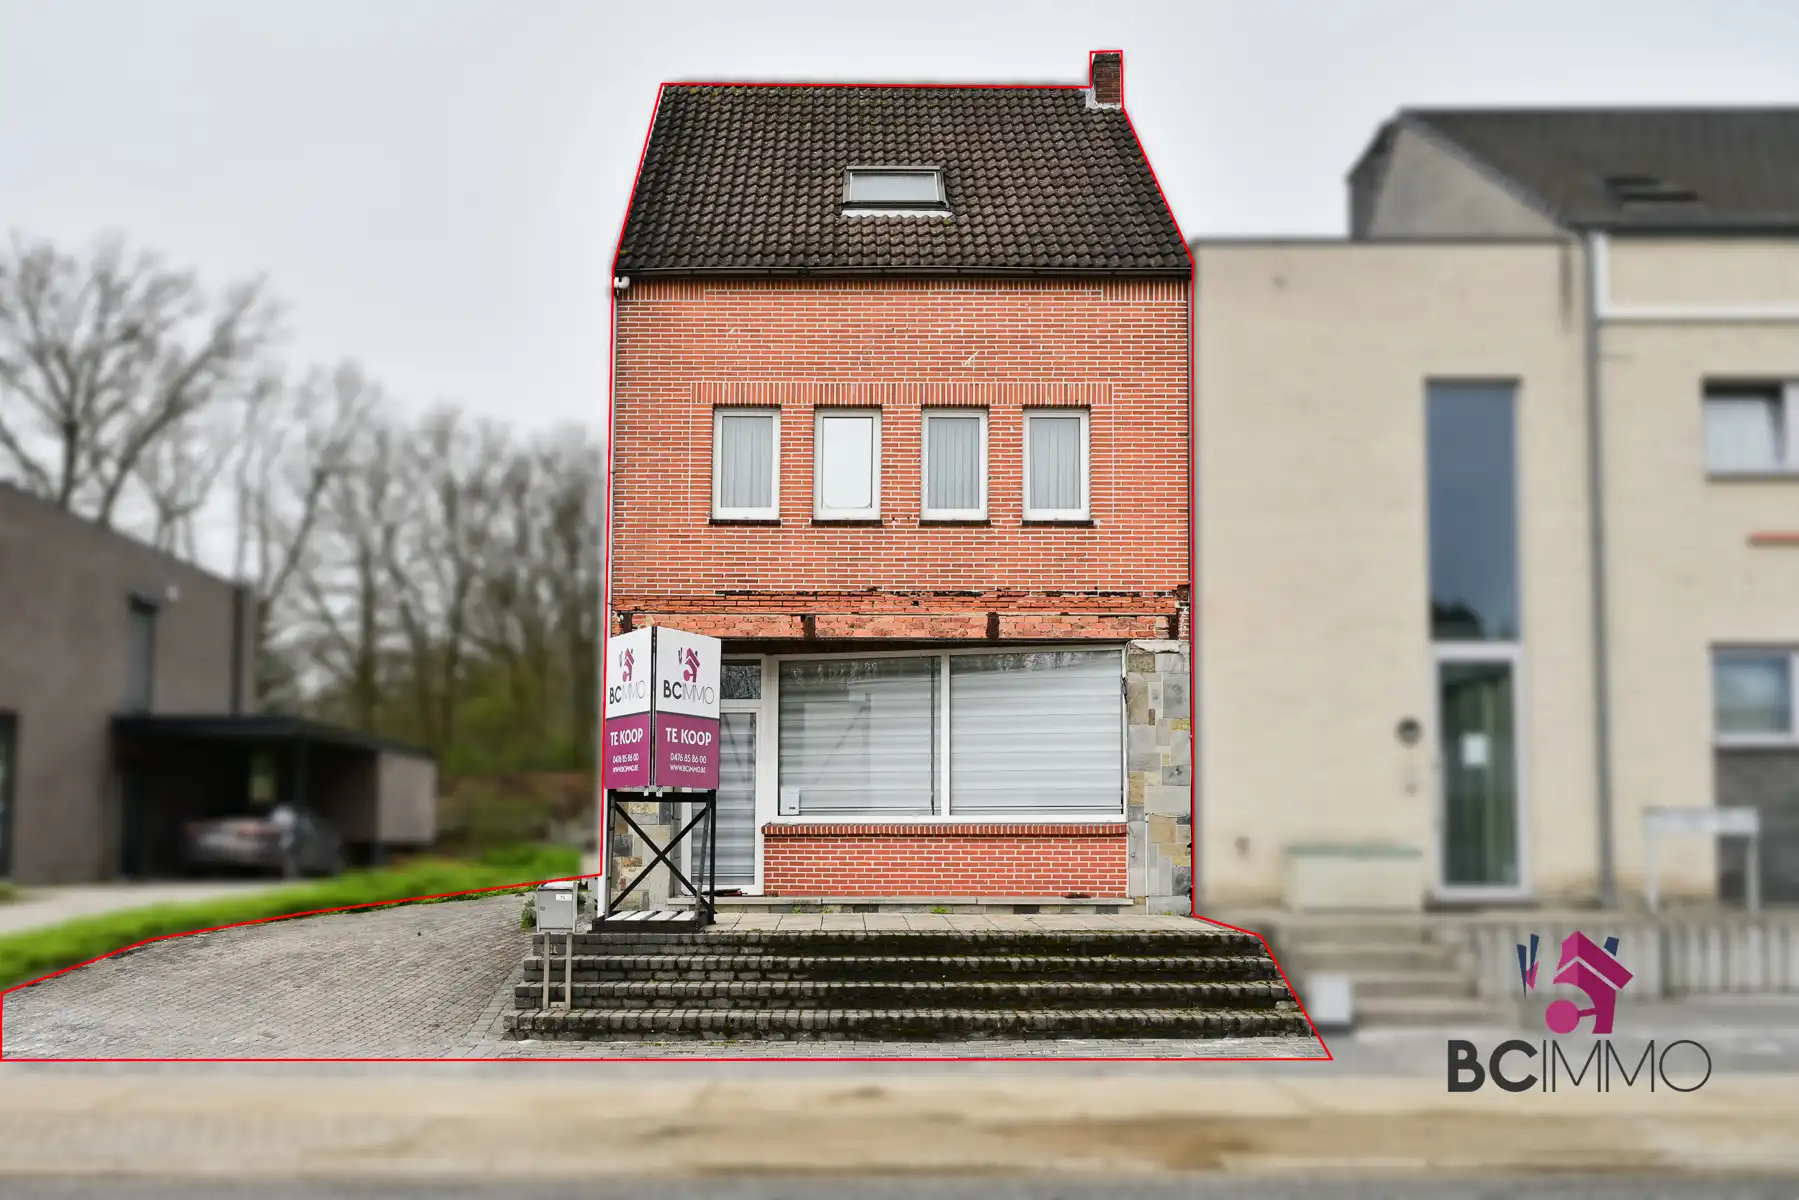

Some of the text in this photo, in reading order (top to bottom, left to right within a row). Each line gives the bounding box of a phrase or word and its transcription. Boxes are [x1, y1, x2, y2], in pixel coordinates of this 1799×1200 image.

[610, 681, 645, 704] BCIMMO
[664, 680, 714, 704] BCIMMO
[610, 728, 643, 746] TE KOOP
[665, 727, 712, 746] TE KOOP
[670, 752, 707, 764] 0476 85 86 00
